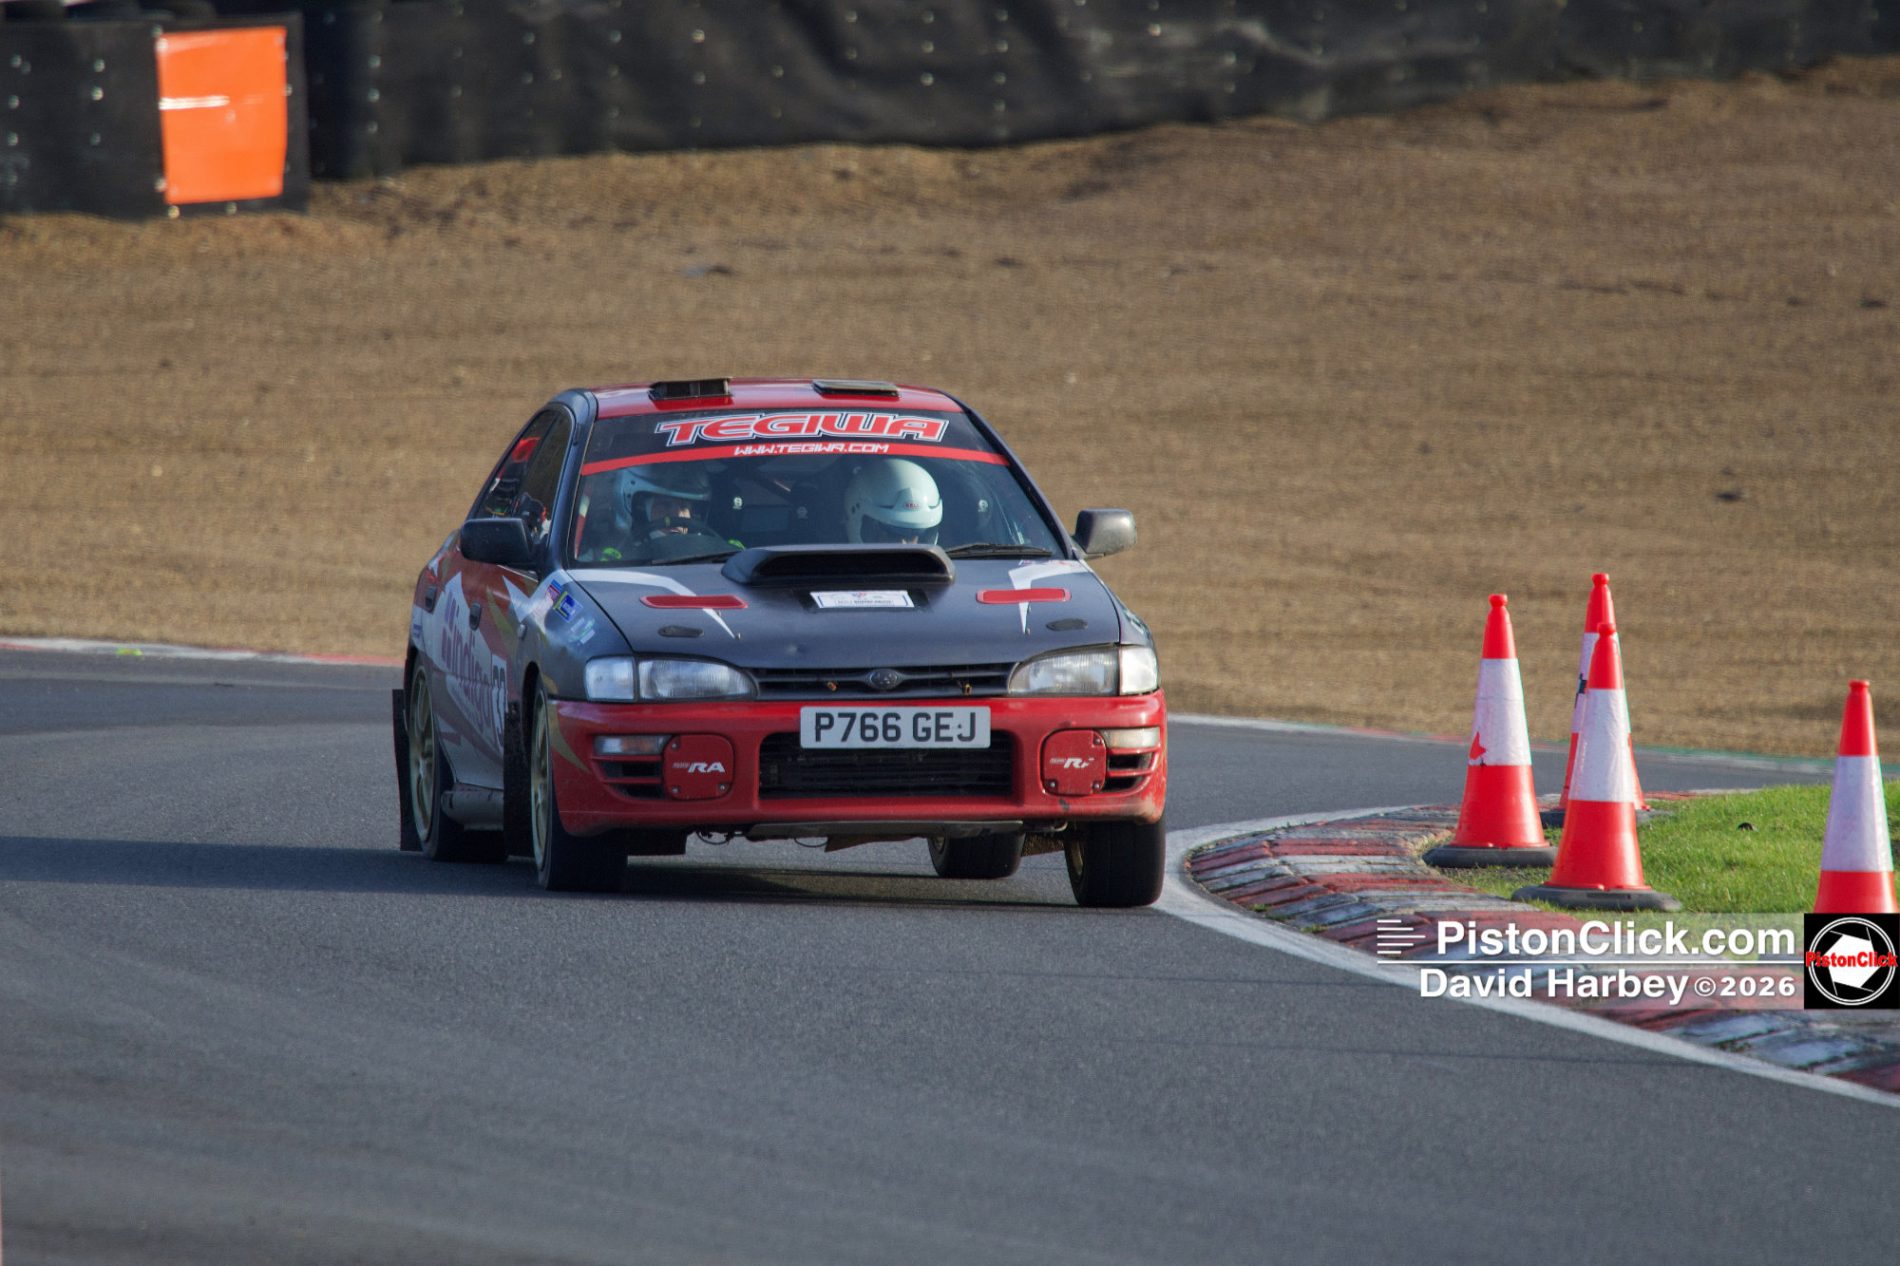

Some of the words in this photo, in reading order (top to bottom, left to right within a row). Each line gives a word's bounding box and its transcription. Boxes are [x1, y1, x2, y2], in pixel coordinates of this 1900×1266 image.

[654, 411, 950, 447] TEGIWA
[734, 441, 889, 456] WWW.TEGIWA.COM
[815, 712, 902, 743] P766
[912, 712, 976, 743] GEJ
[687, 761, 726, 774] RA
